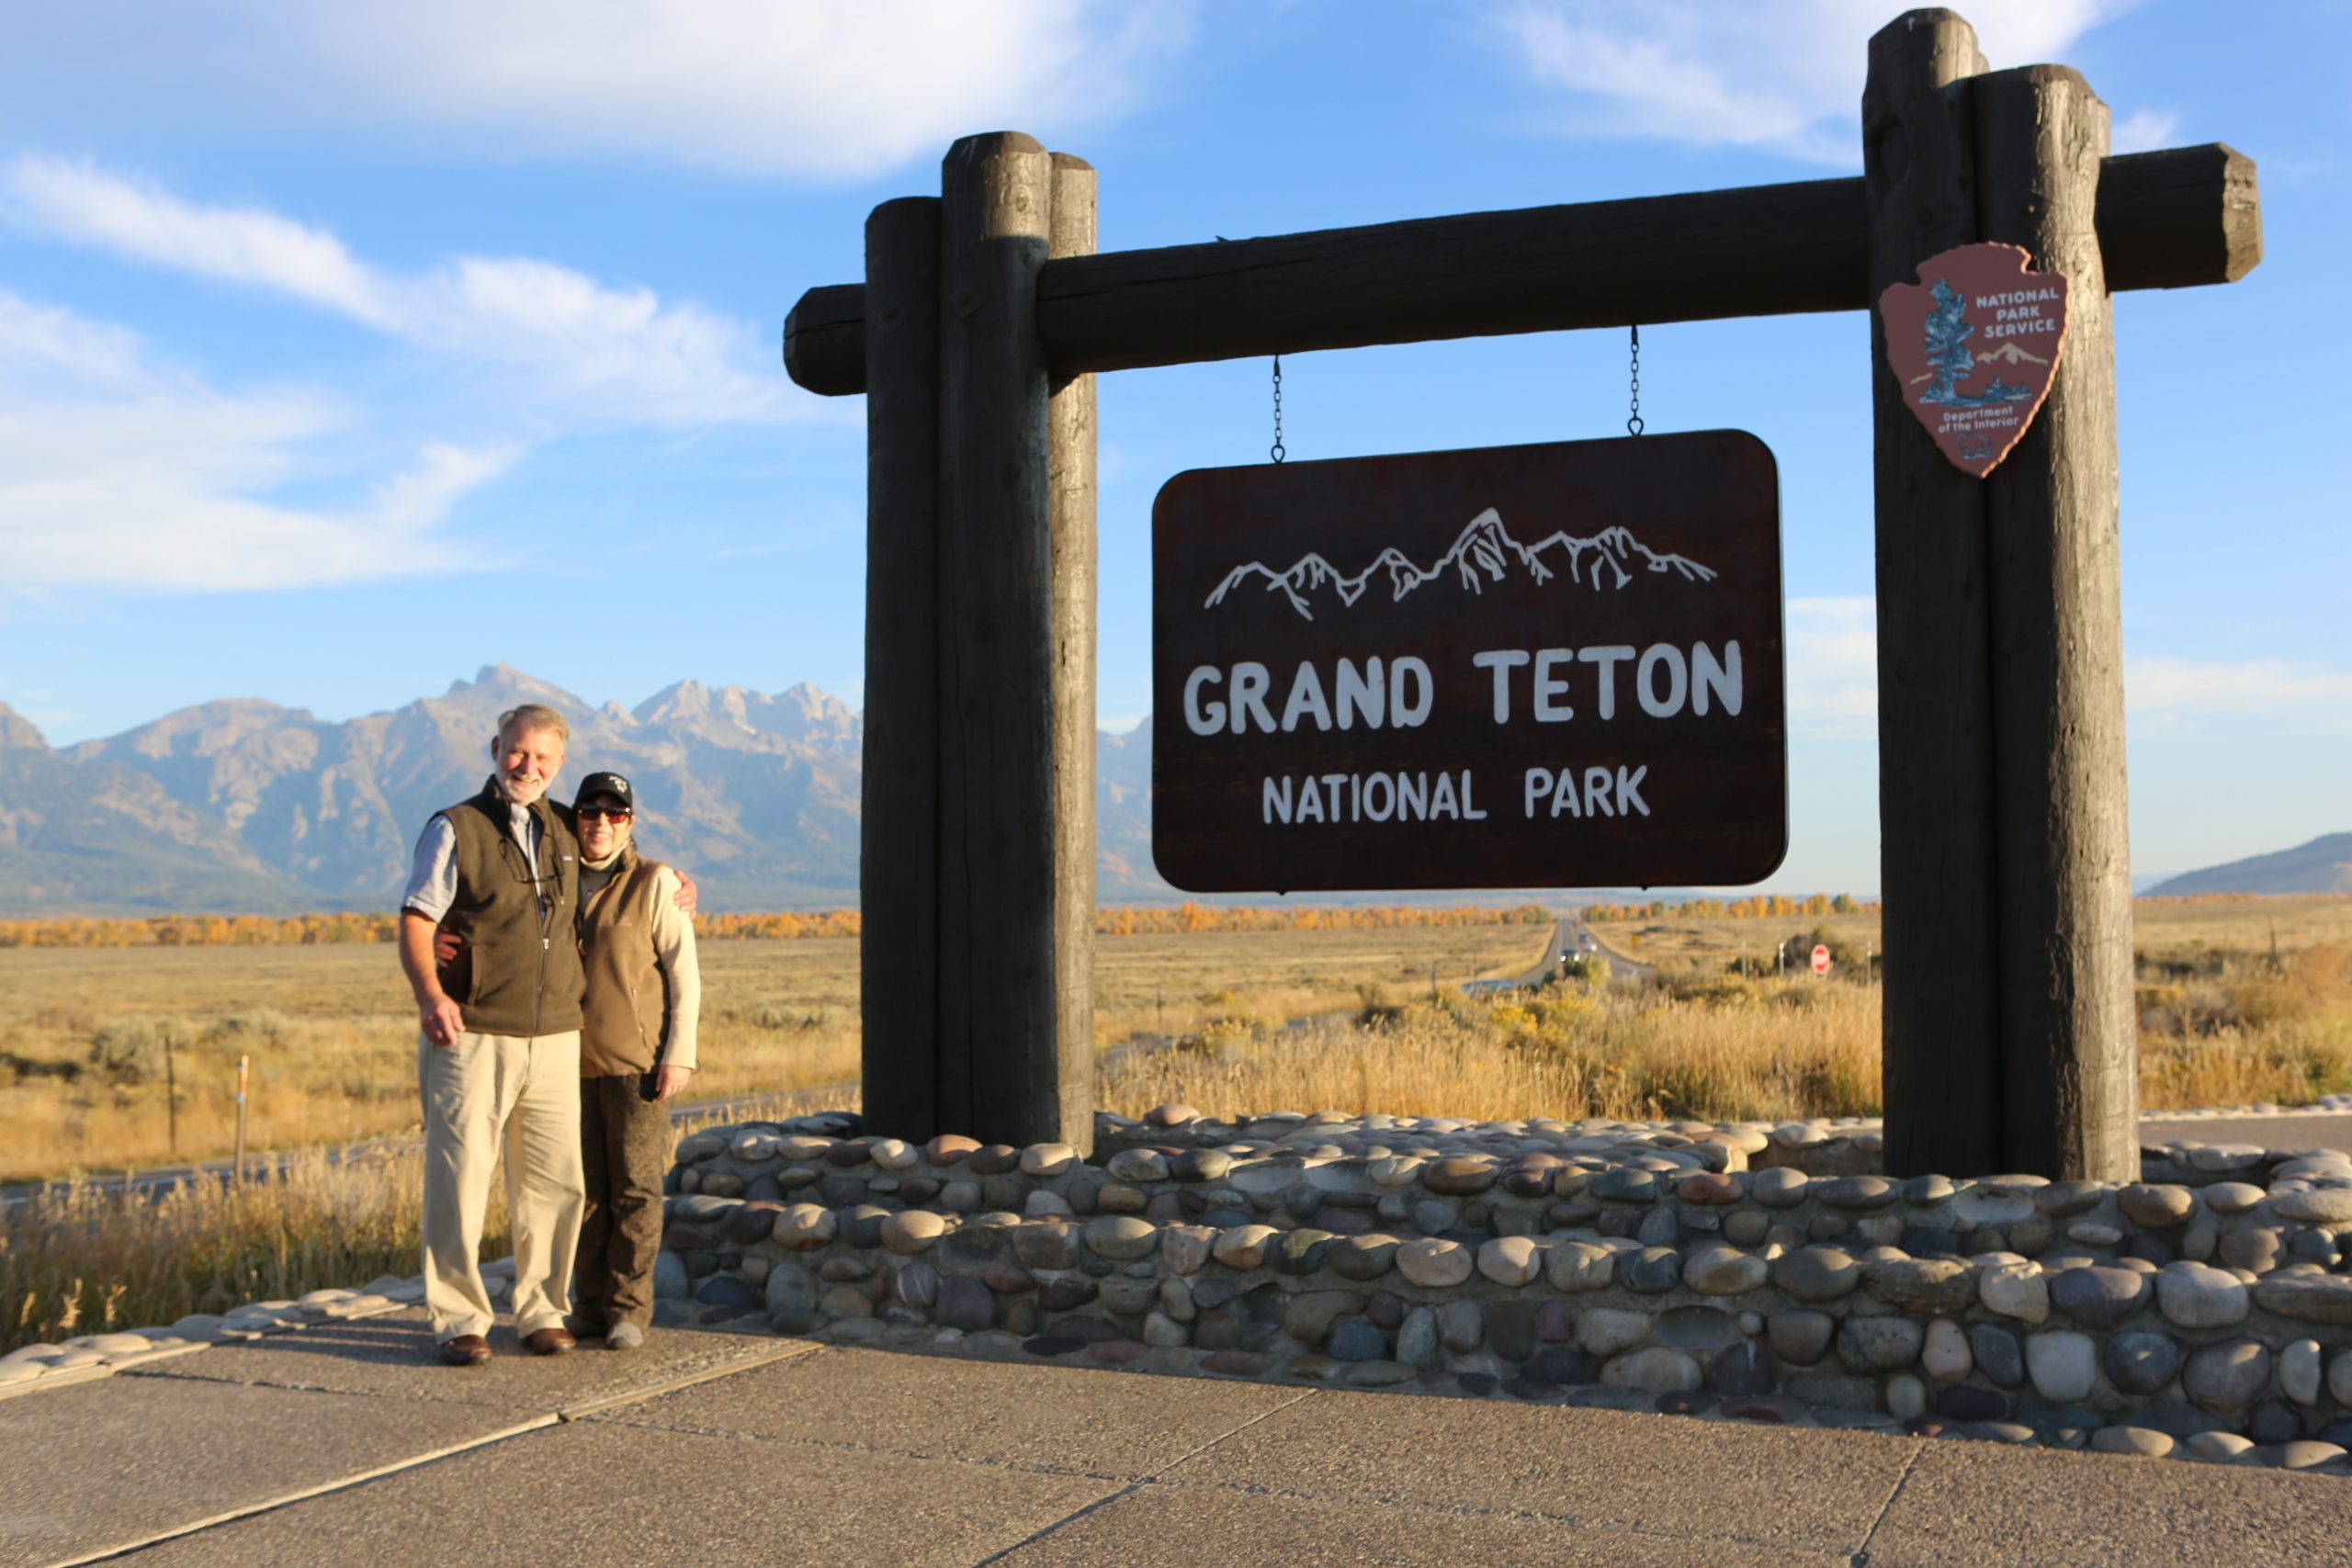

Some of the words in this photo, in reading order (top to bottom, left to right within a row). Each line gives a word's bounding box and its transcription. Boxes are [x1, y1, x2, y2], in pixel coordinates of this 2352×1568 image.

[1976, 287, 2060, 309] NATIONAL
[1996, 305, 2041, 321] PARK
[1984, 318, 2055, 338] SERVICE
[1943, 405, 2014, 423] Department
[1938, 423, 1951, 434] of
[1952, 422, 1972, 432] the
[1973, 416, 2019, 430] Interior
[1183, 655, 1434, 736] GRAND
[1473, 639, 1743, 725] TETON
[1262, 769, 1487, 824] NATIONAL
[1524, 764, 1651, 818] PARK
